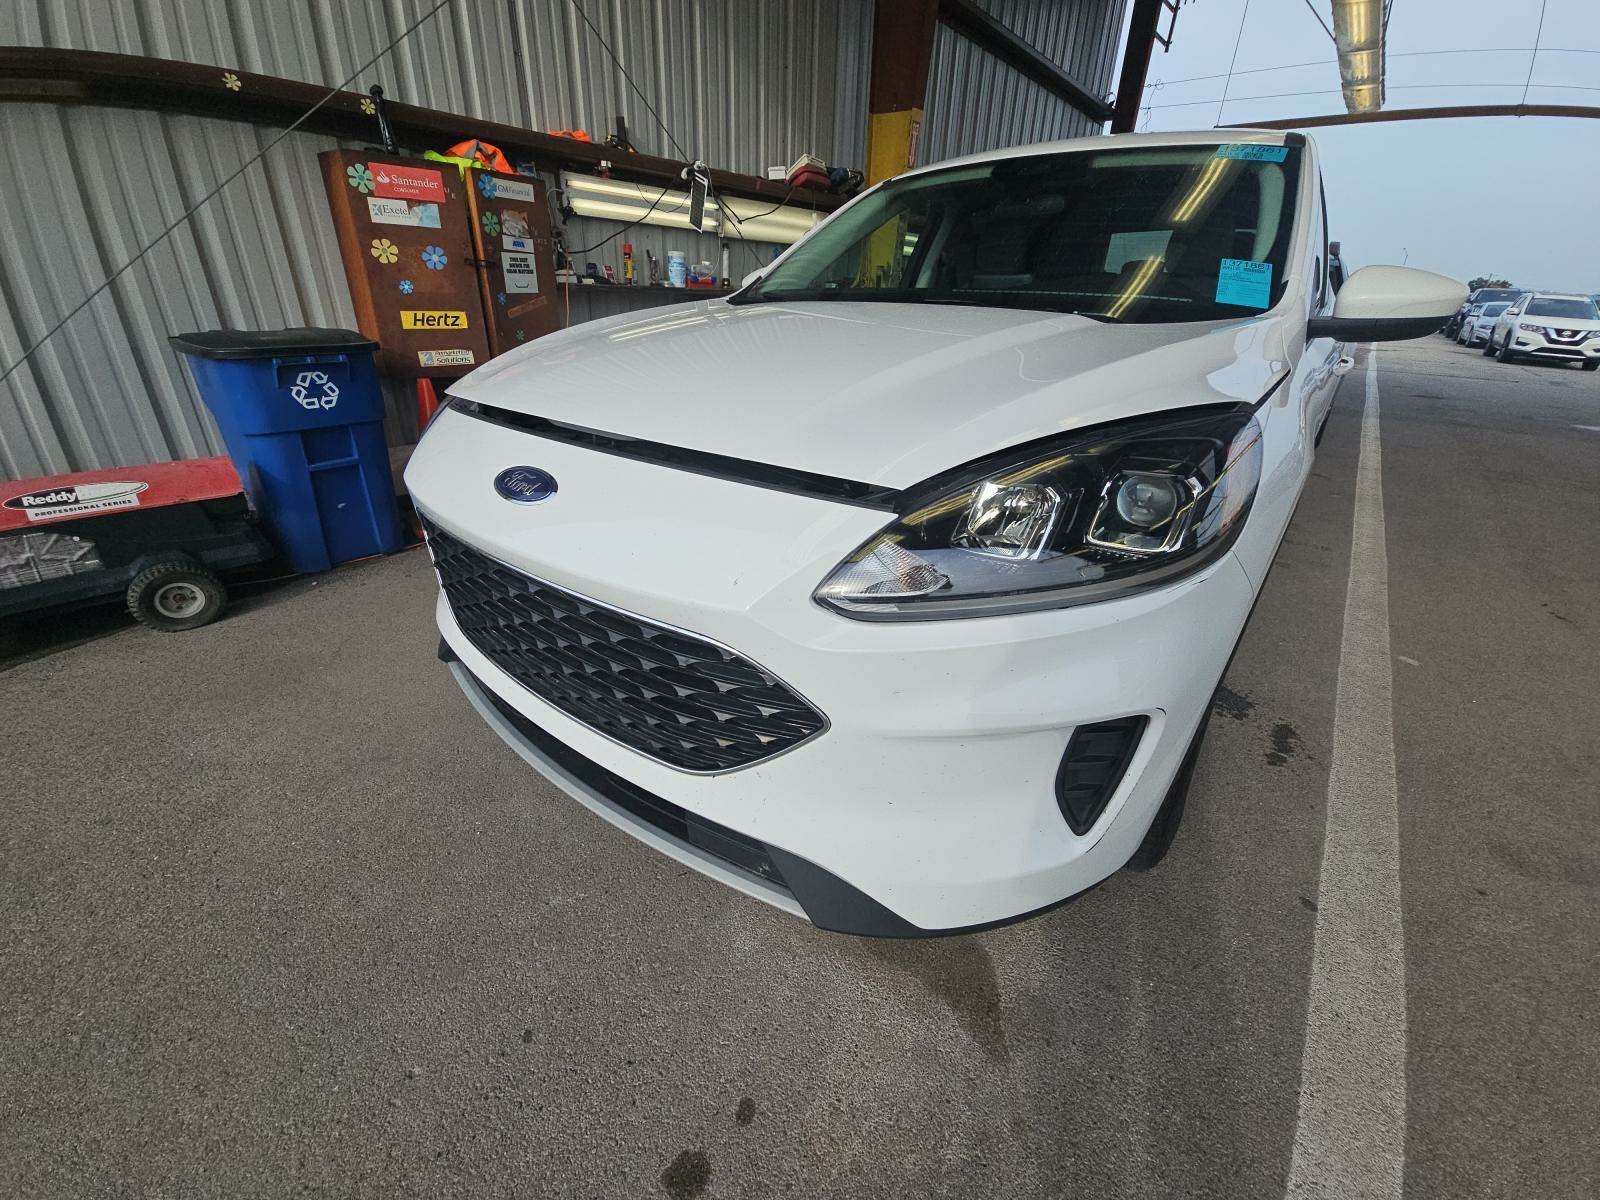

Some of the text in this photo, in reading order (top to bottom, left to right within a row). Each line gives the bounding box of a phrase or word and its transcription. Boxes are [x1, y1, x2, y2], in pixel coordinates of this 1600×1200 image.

[391, 174, 439, 189] Santander
[413, 313, 460, 327] Hertz
[504, 471, 542, 496] Ford
[21, 491, 77, 507] Reddy
[34, 499, 133, 517] PROFESSIONAL SERIES
